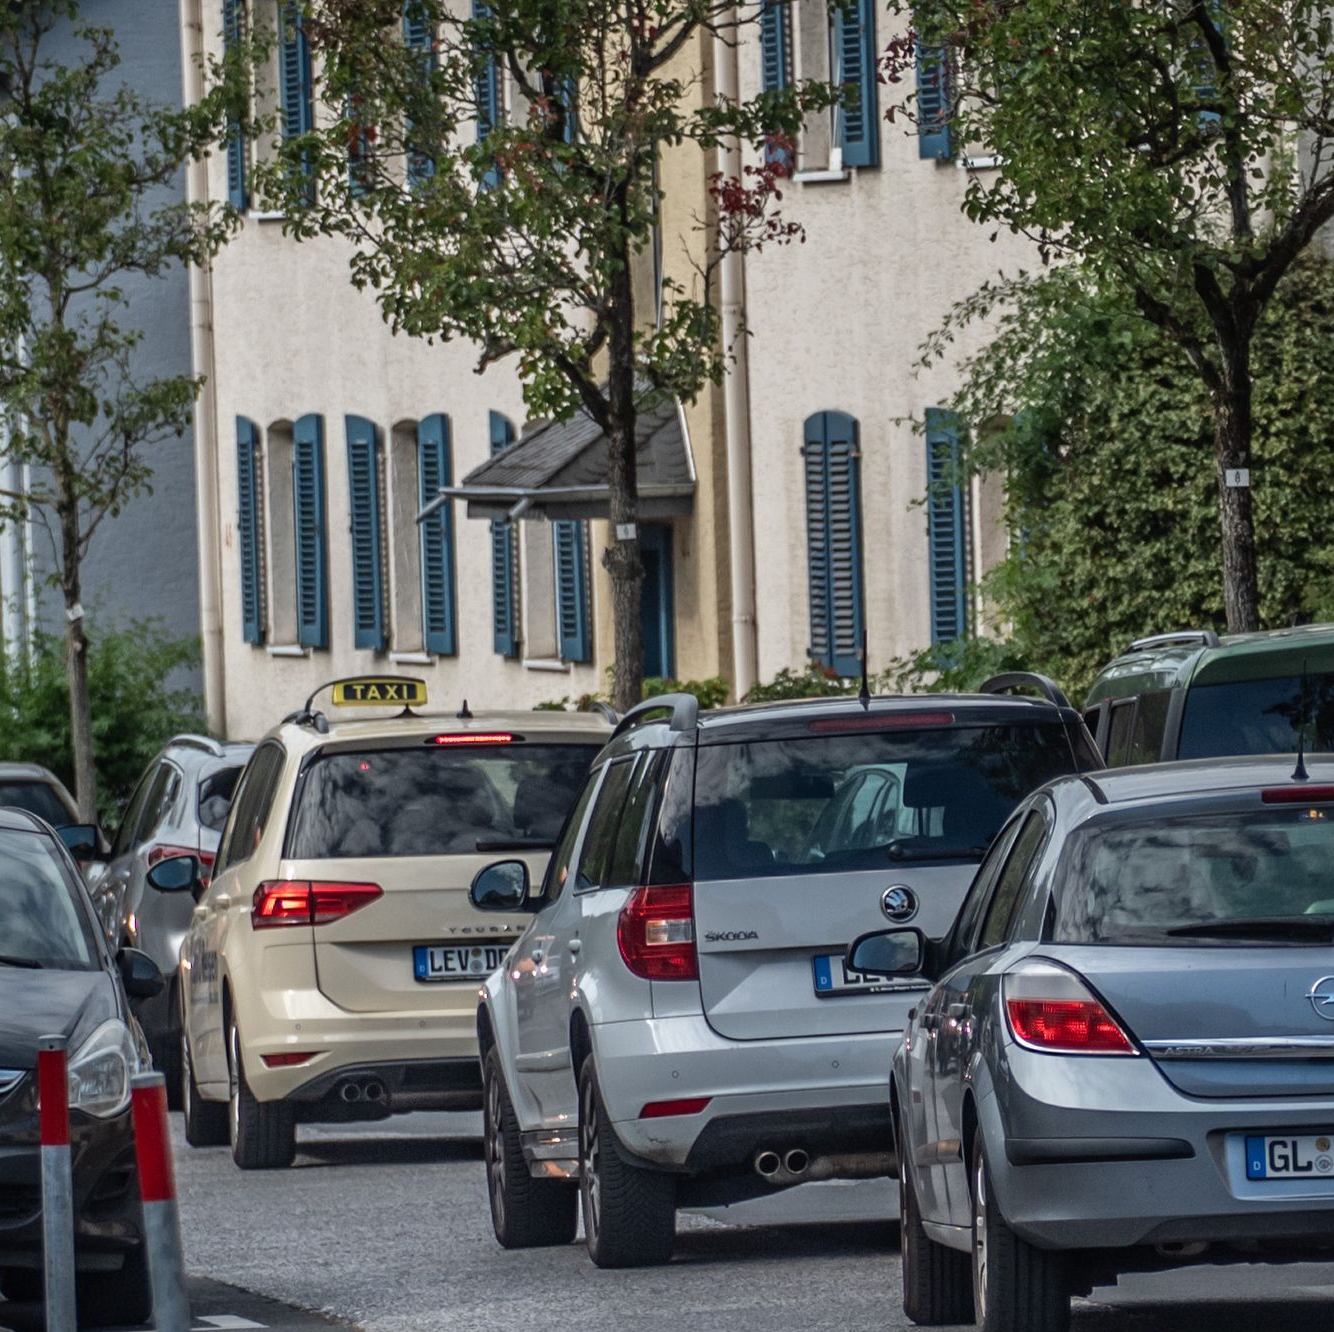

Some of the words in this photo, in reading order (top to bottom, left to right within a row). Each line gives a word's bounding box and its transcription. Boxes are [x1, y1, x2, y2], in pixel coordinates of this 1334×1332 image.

[352, 685, 408, 700] TAXI
[429, 949, 469, 972] LEV
[820, 976, 827, 985] D
[1164, 1046, 1214, 1056] ASTRA
[1253, 1161, 1261, 1171] D
[1269, 1140, 1313, 1172] GL
